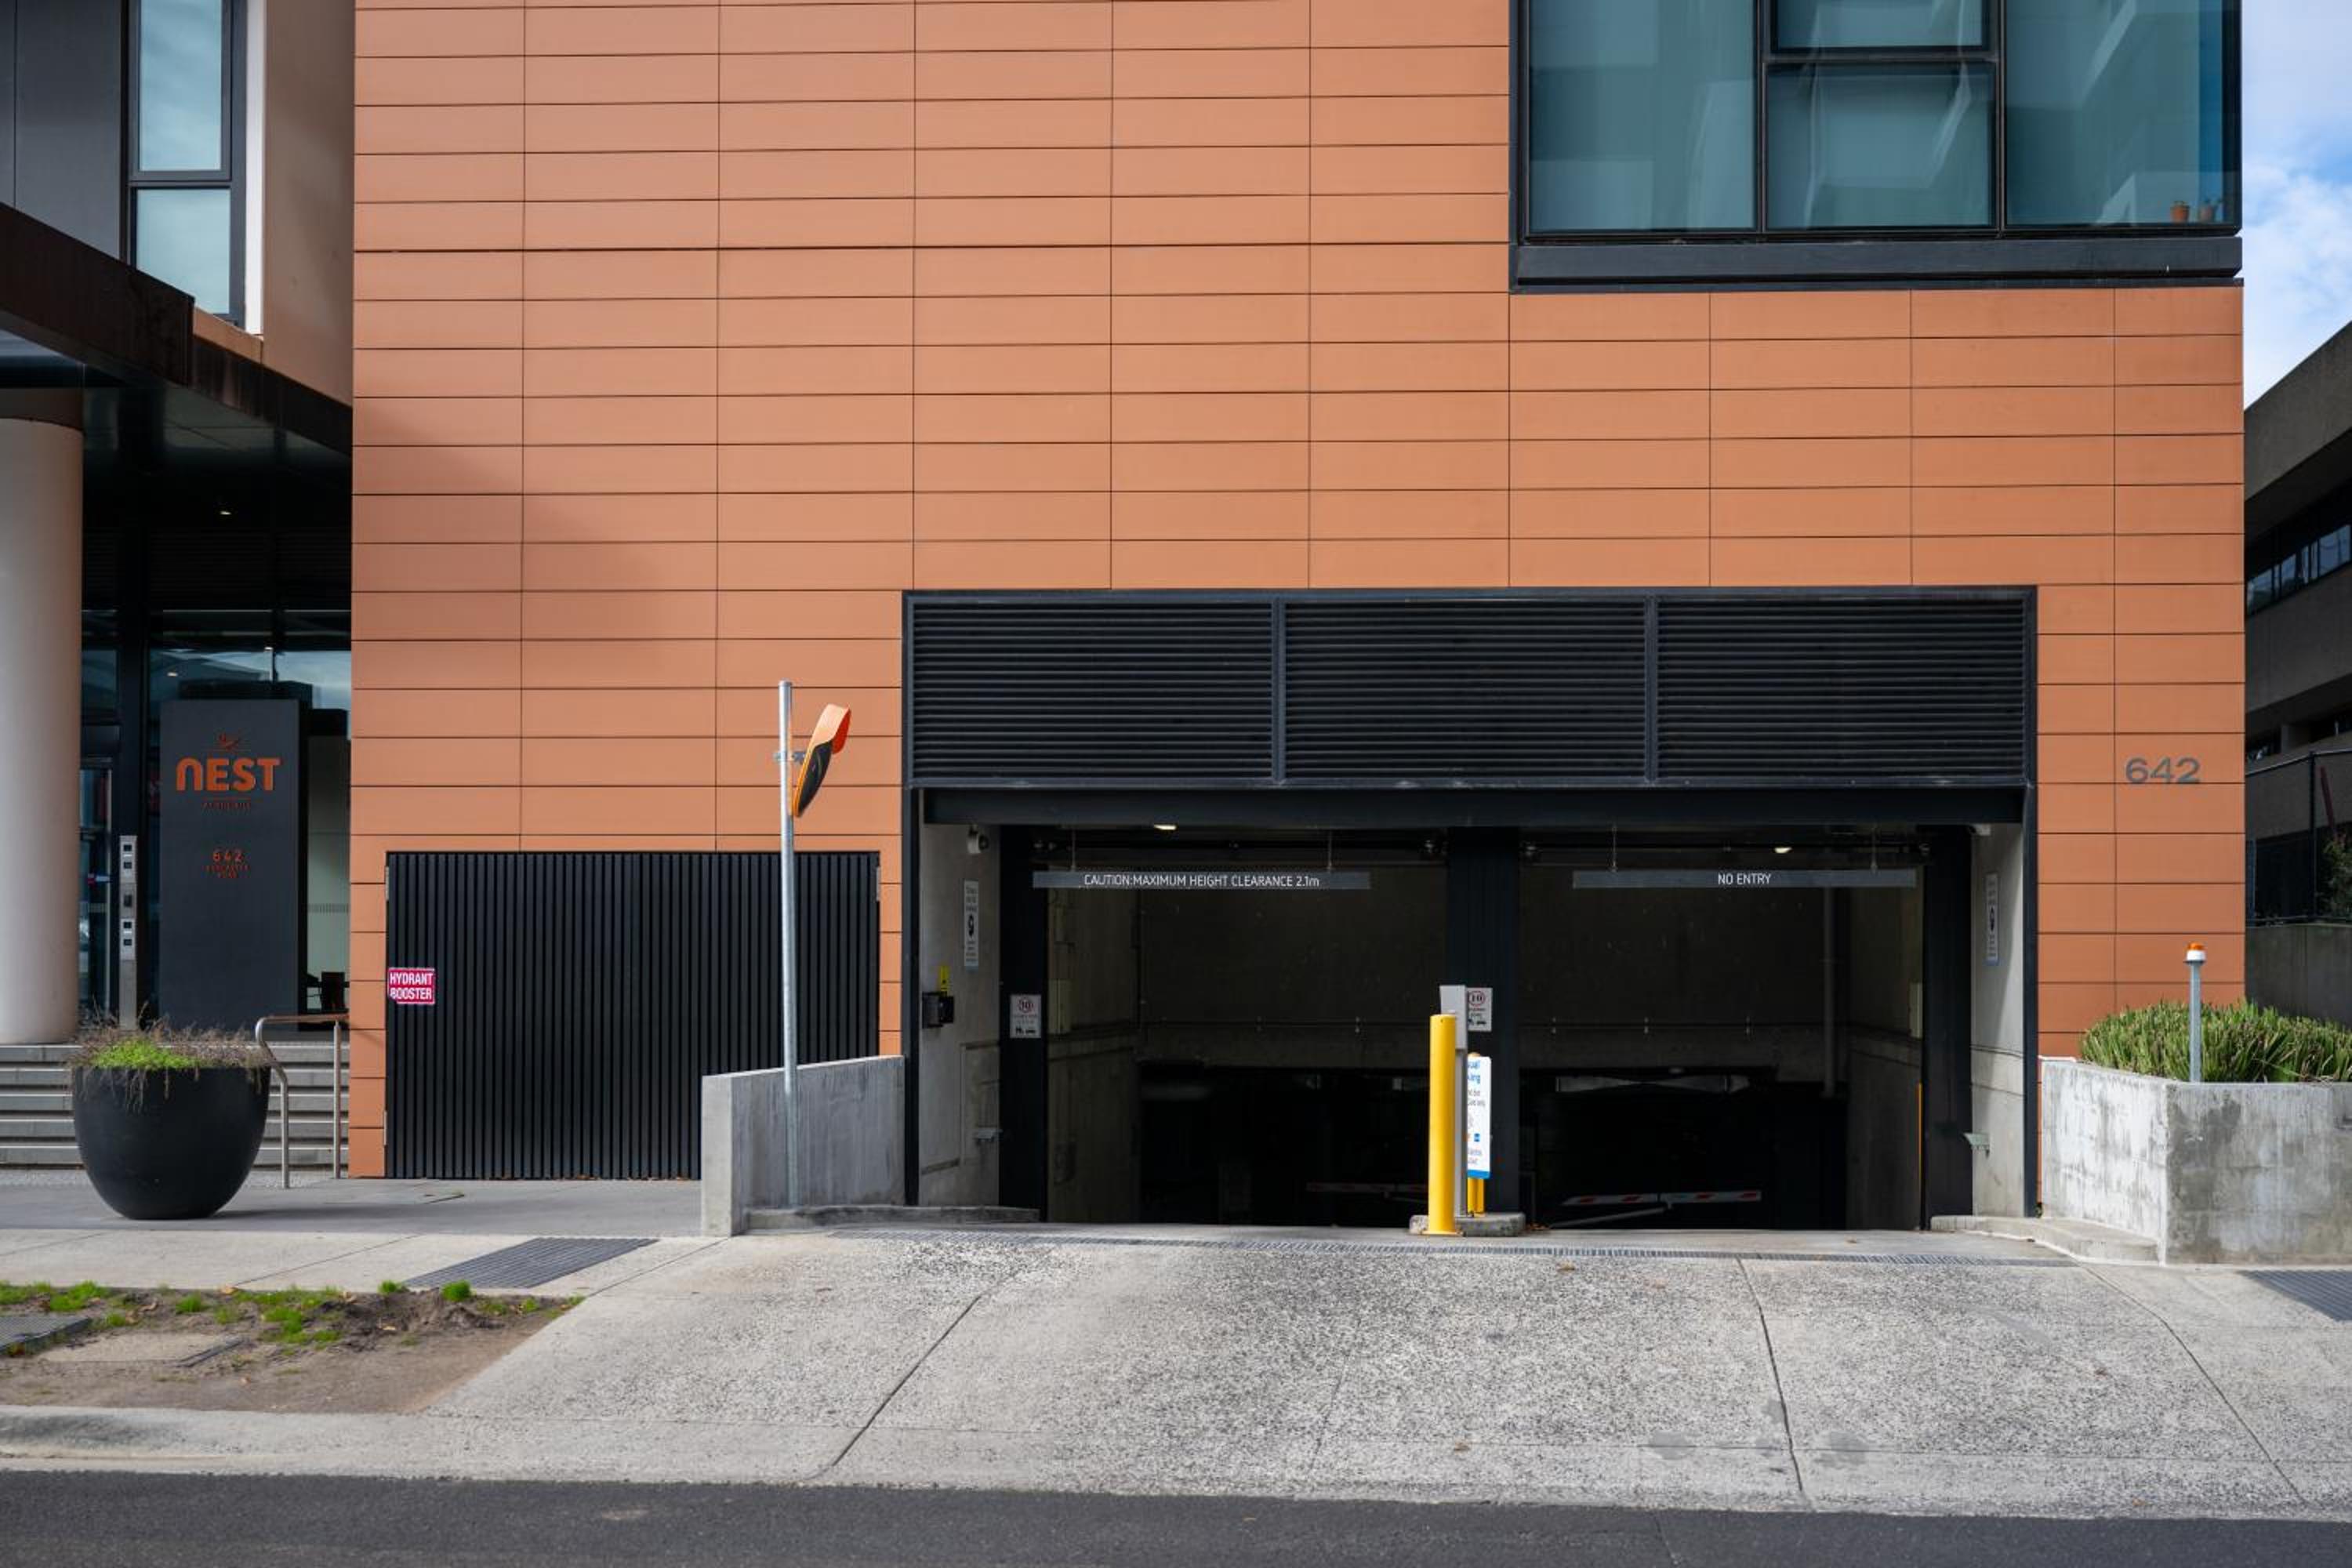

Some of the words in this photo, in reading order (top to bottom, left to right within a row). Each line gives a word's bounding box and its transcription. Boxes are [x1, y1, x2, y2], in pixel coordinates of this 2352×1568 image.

[2125, 757, 2200, 784] 642
[1189, 874, 1228, 887] HEIGHT
[1231, 875, 1293, 887] CLEARANCE
[1296, 875, 1320, 887] 2.1m
[1718, 873, 1733, 885] NO
[1737, 873, 1771, 885] ENTRY
[390, 972, 433, 985] HYDRANT
[390, 987, 432, 1000] BOOSTER
